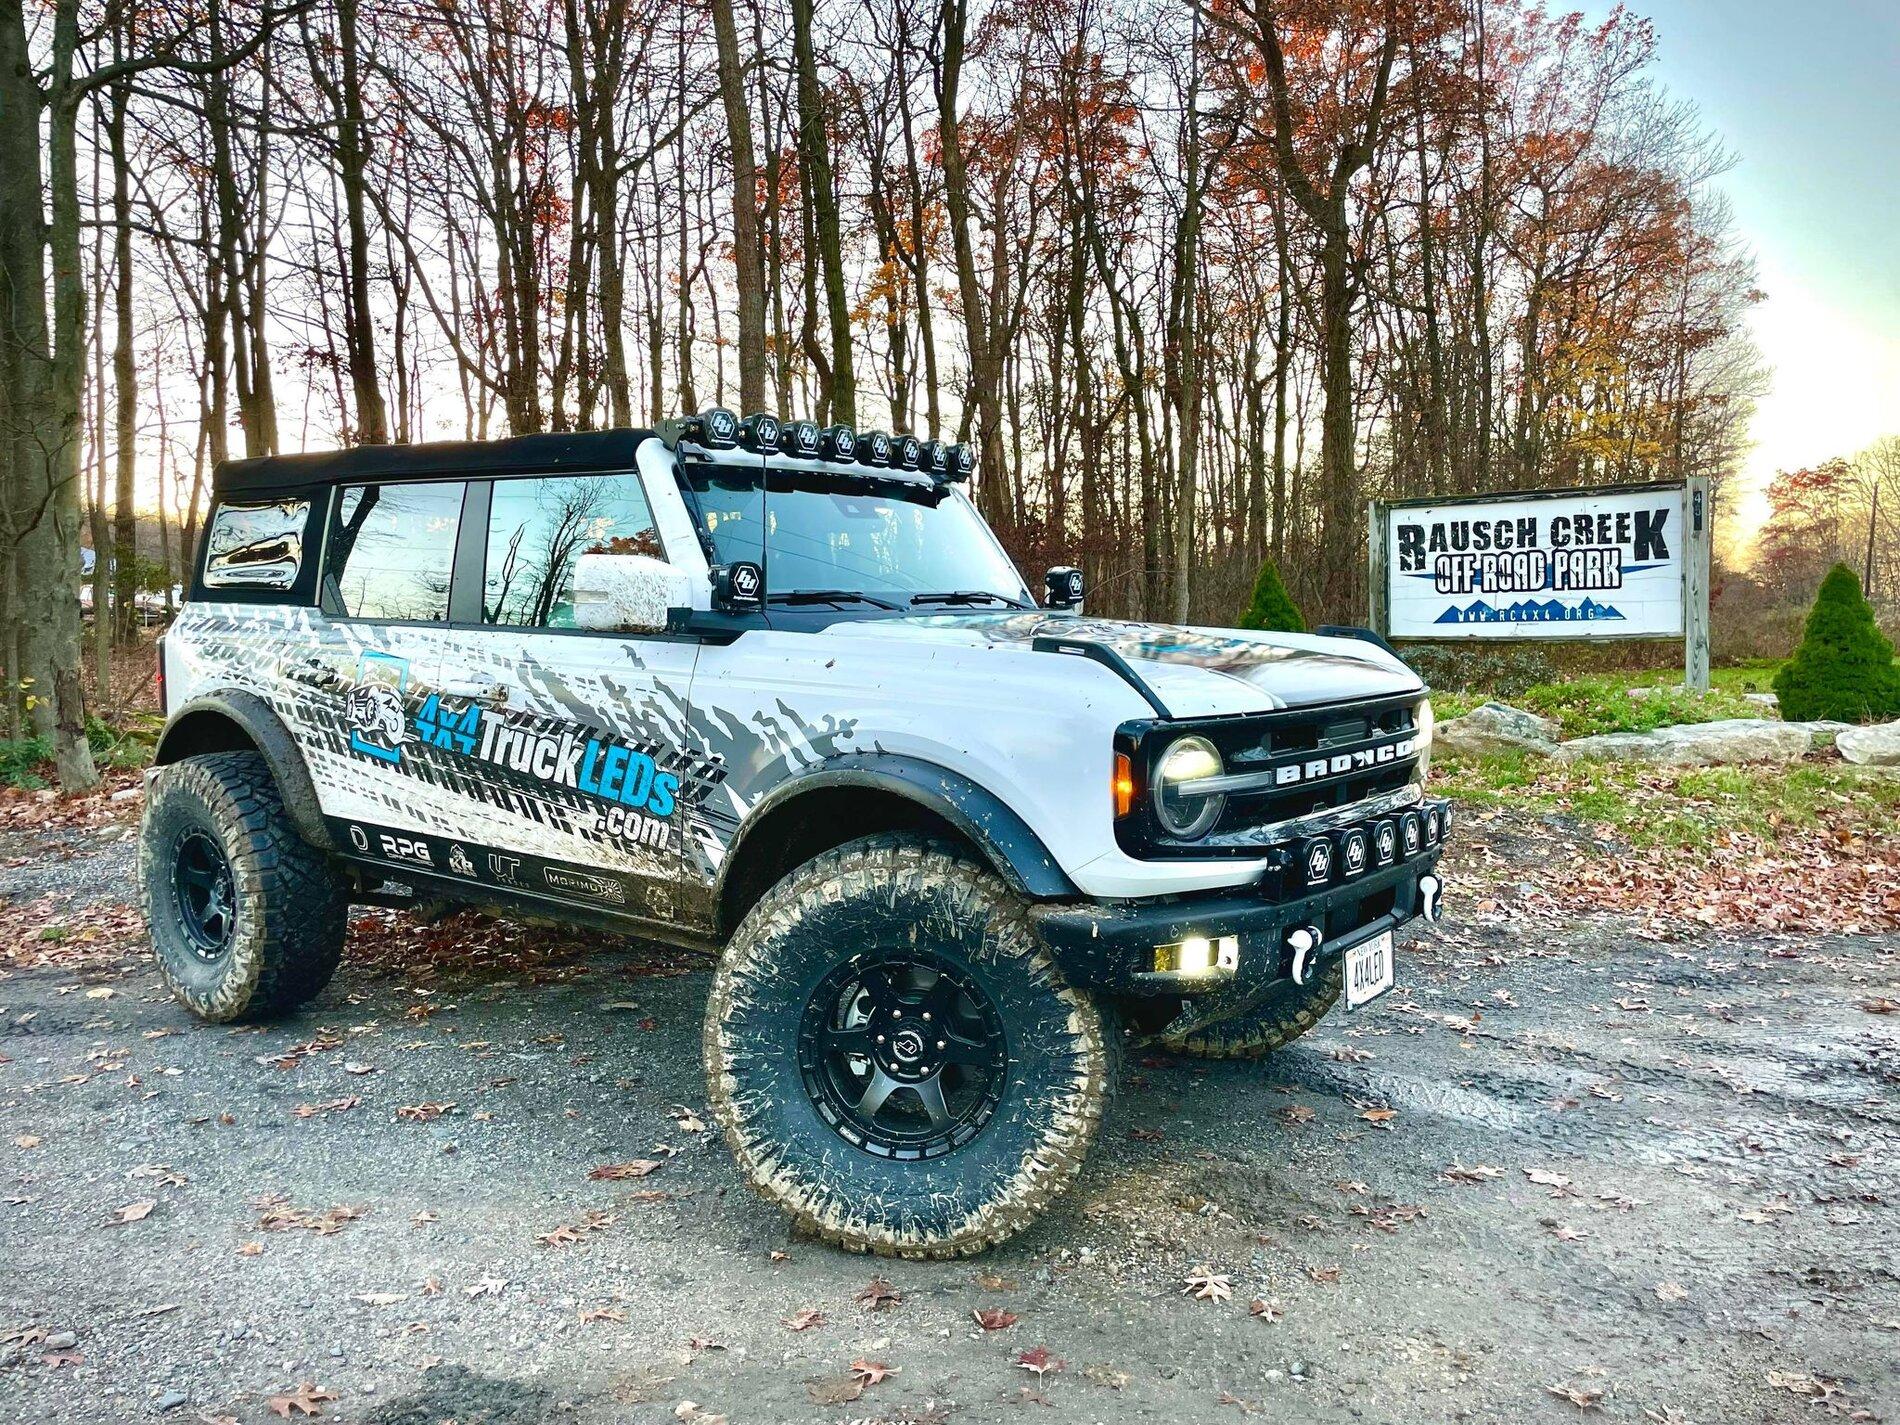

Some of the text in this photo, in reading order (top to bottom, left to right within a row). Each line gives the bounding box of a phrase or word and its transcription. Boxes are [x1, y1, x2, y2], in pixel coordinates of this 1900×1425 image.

[1397, 508, 1670, 571] RAUSCH CREEK
[1435, 548, 1622, 595] OFF ROAD PARK
[1457, 608, 1595, 622] WWW.RC4X4.ORG
[1276, 740, 1415, 785] BRONCO
[380, 834, 431, 861] RPG
